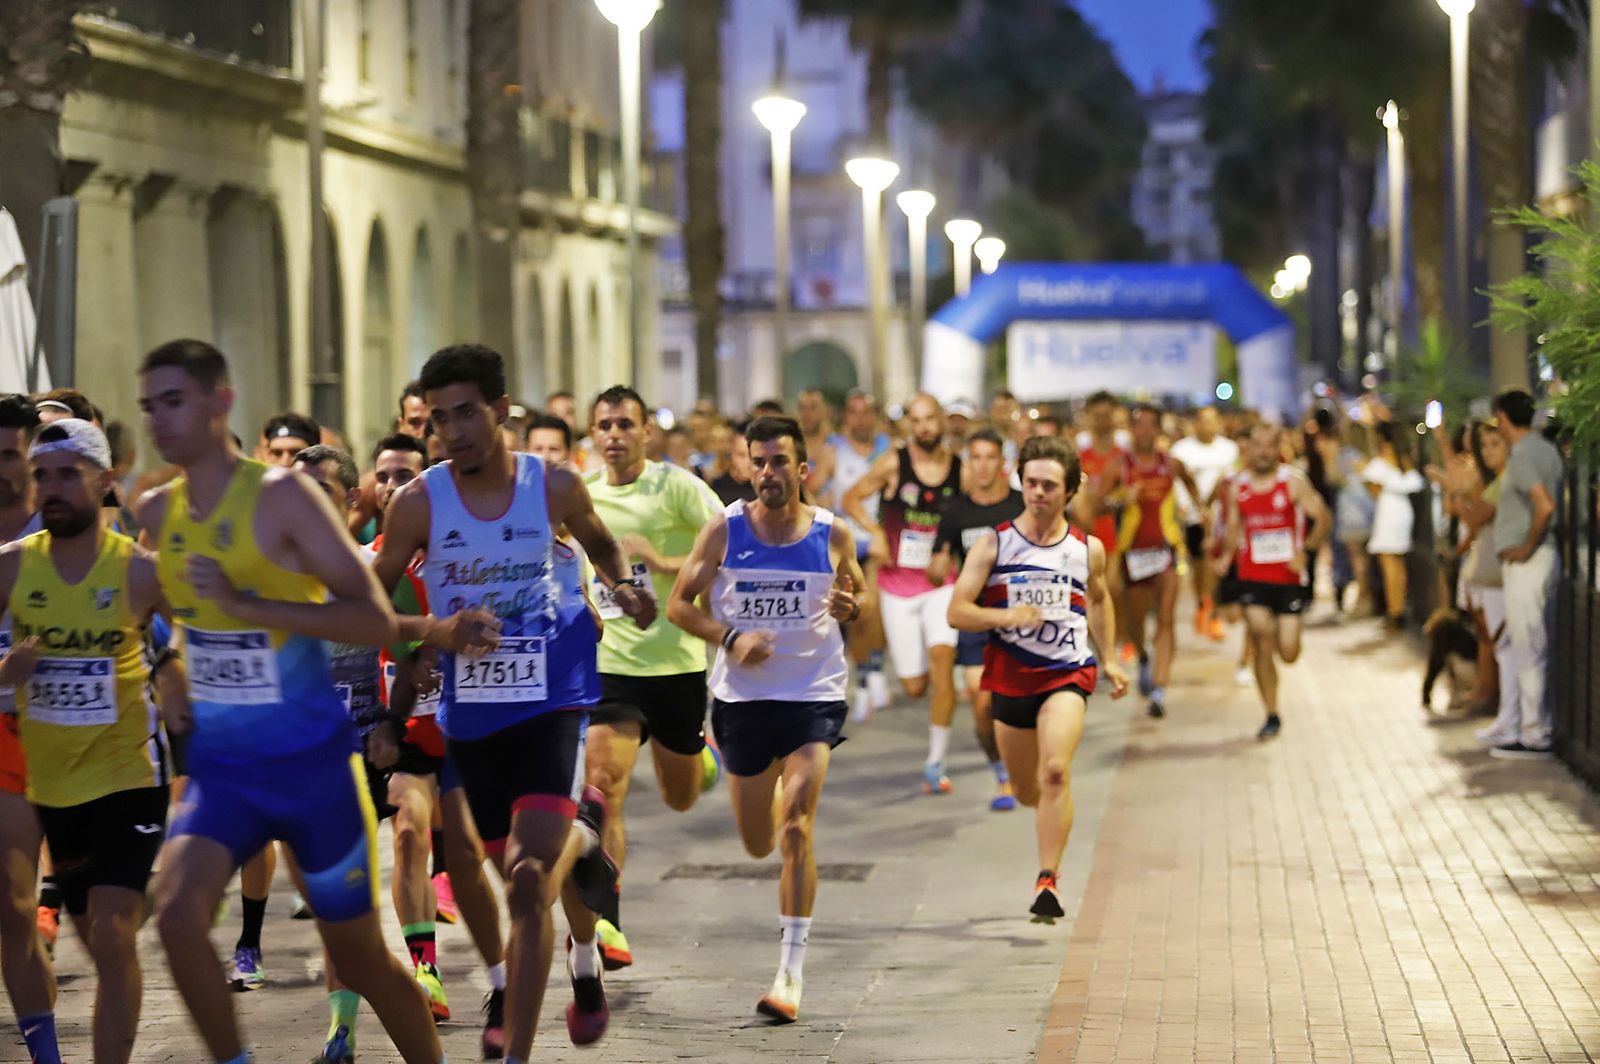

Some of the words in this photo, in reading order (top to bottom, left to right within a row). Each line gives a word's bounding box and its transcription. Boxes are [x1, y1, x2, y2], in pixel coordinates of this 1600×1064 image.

[1018, 277, 1115, 305] Huelva
[1024, 328, 1189, 367] Huelva
[754, 597, 787, 616] 578
[1025, 589, 1054, 606] 303
[1000, 620, 1077, 650] ODA
[479, 660, 517, 684] 751
[43, 682, 87, 707] 655
